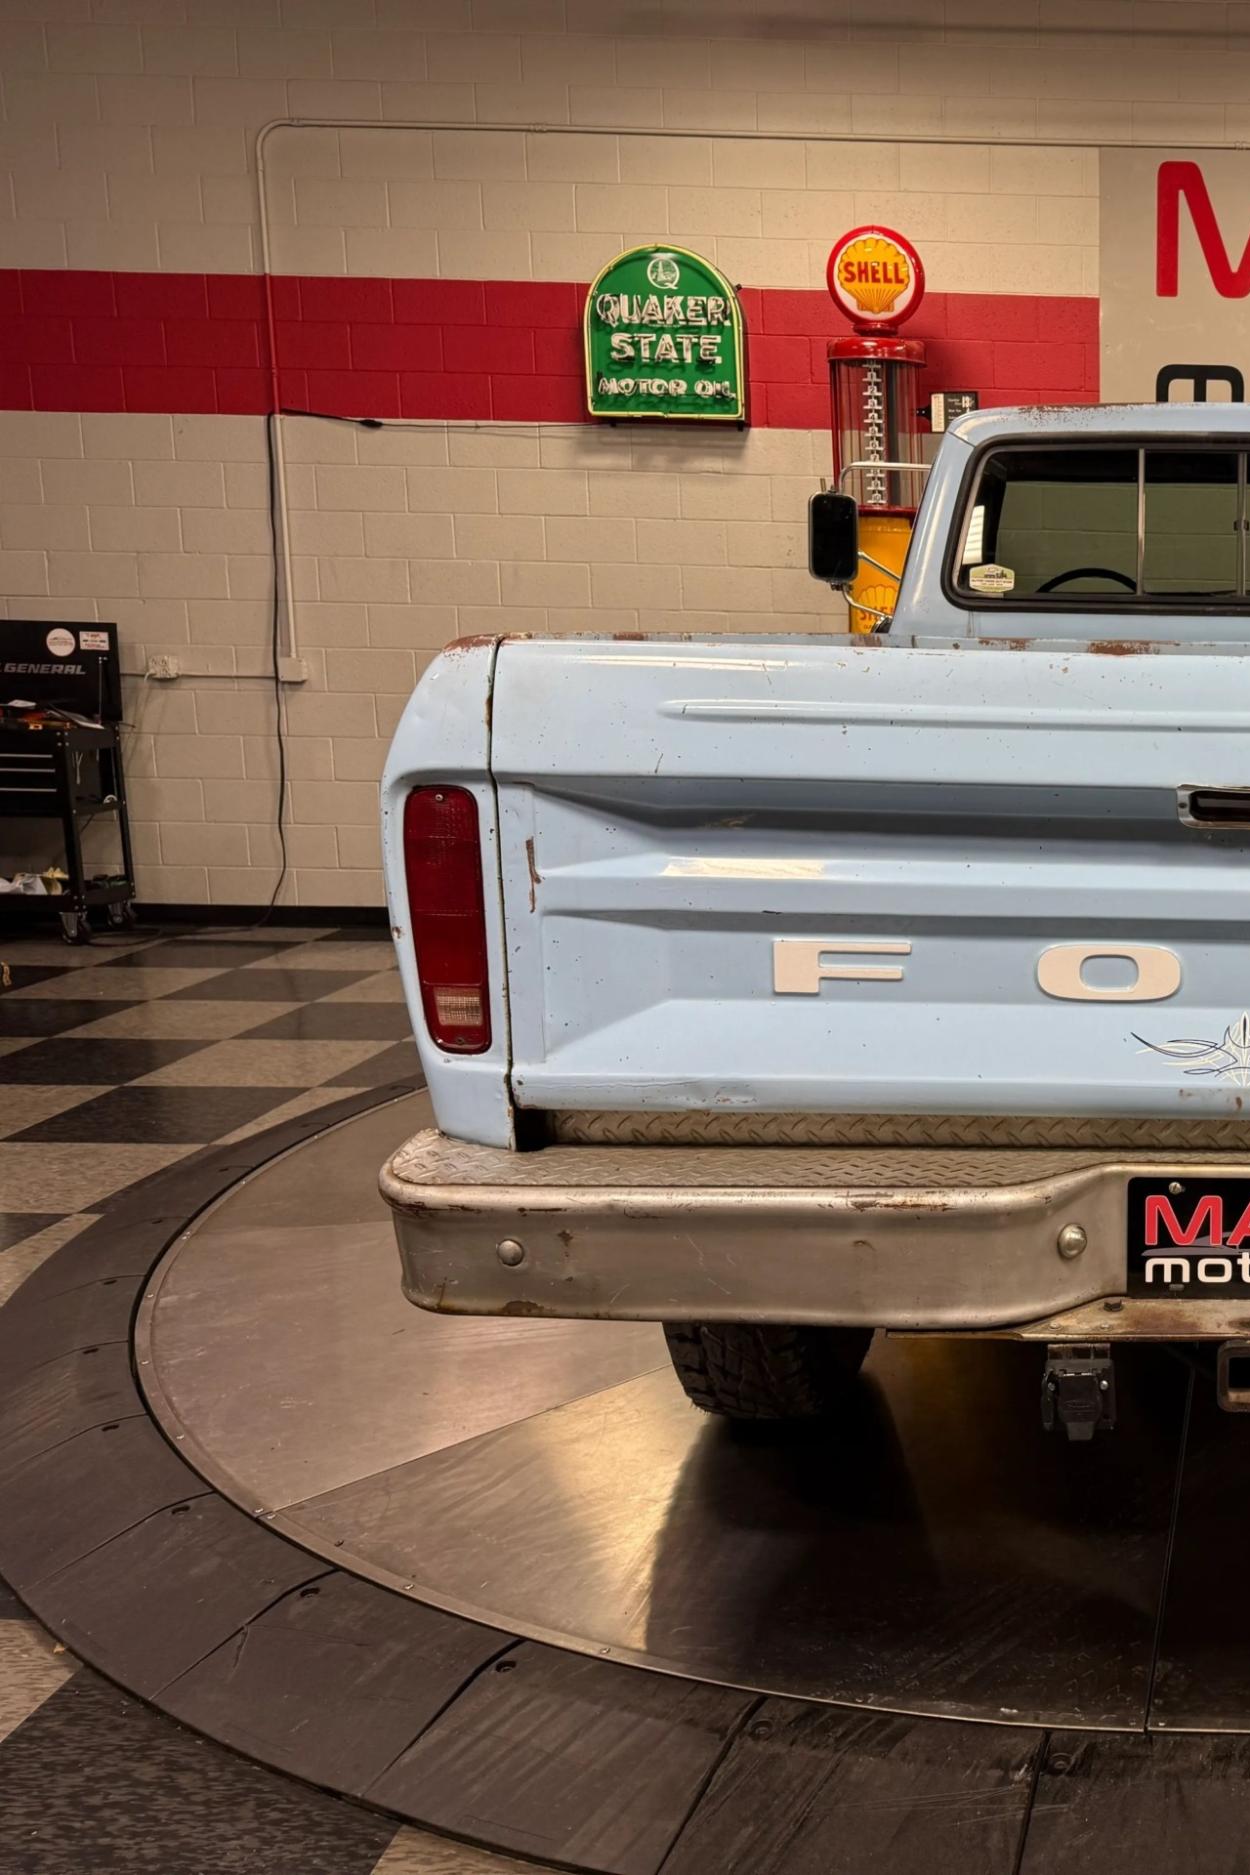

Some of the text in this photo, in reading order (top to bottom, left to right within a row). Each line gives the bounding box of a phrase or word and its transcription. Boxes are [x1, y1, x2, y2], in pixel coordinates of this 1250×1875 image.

[843, 261, 905, 284] SHELL
[596, 293, 731, 327] QUAKER
[610, 332, 722, 364] STATE
[598, 376, 736, 399] MOTOR OIL
[4, 663, 86, 675] GENERAL
